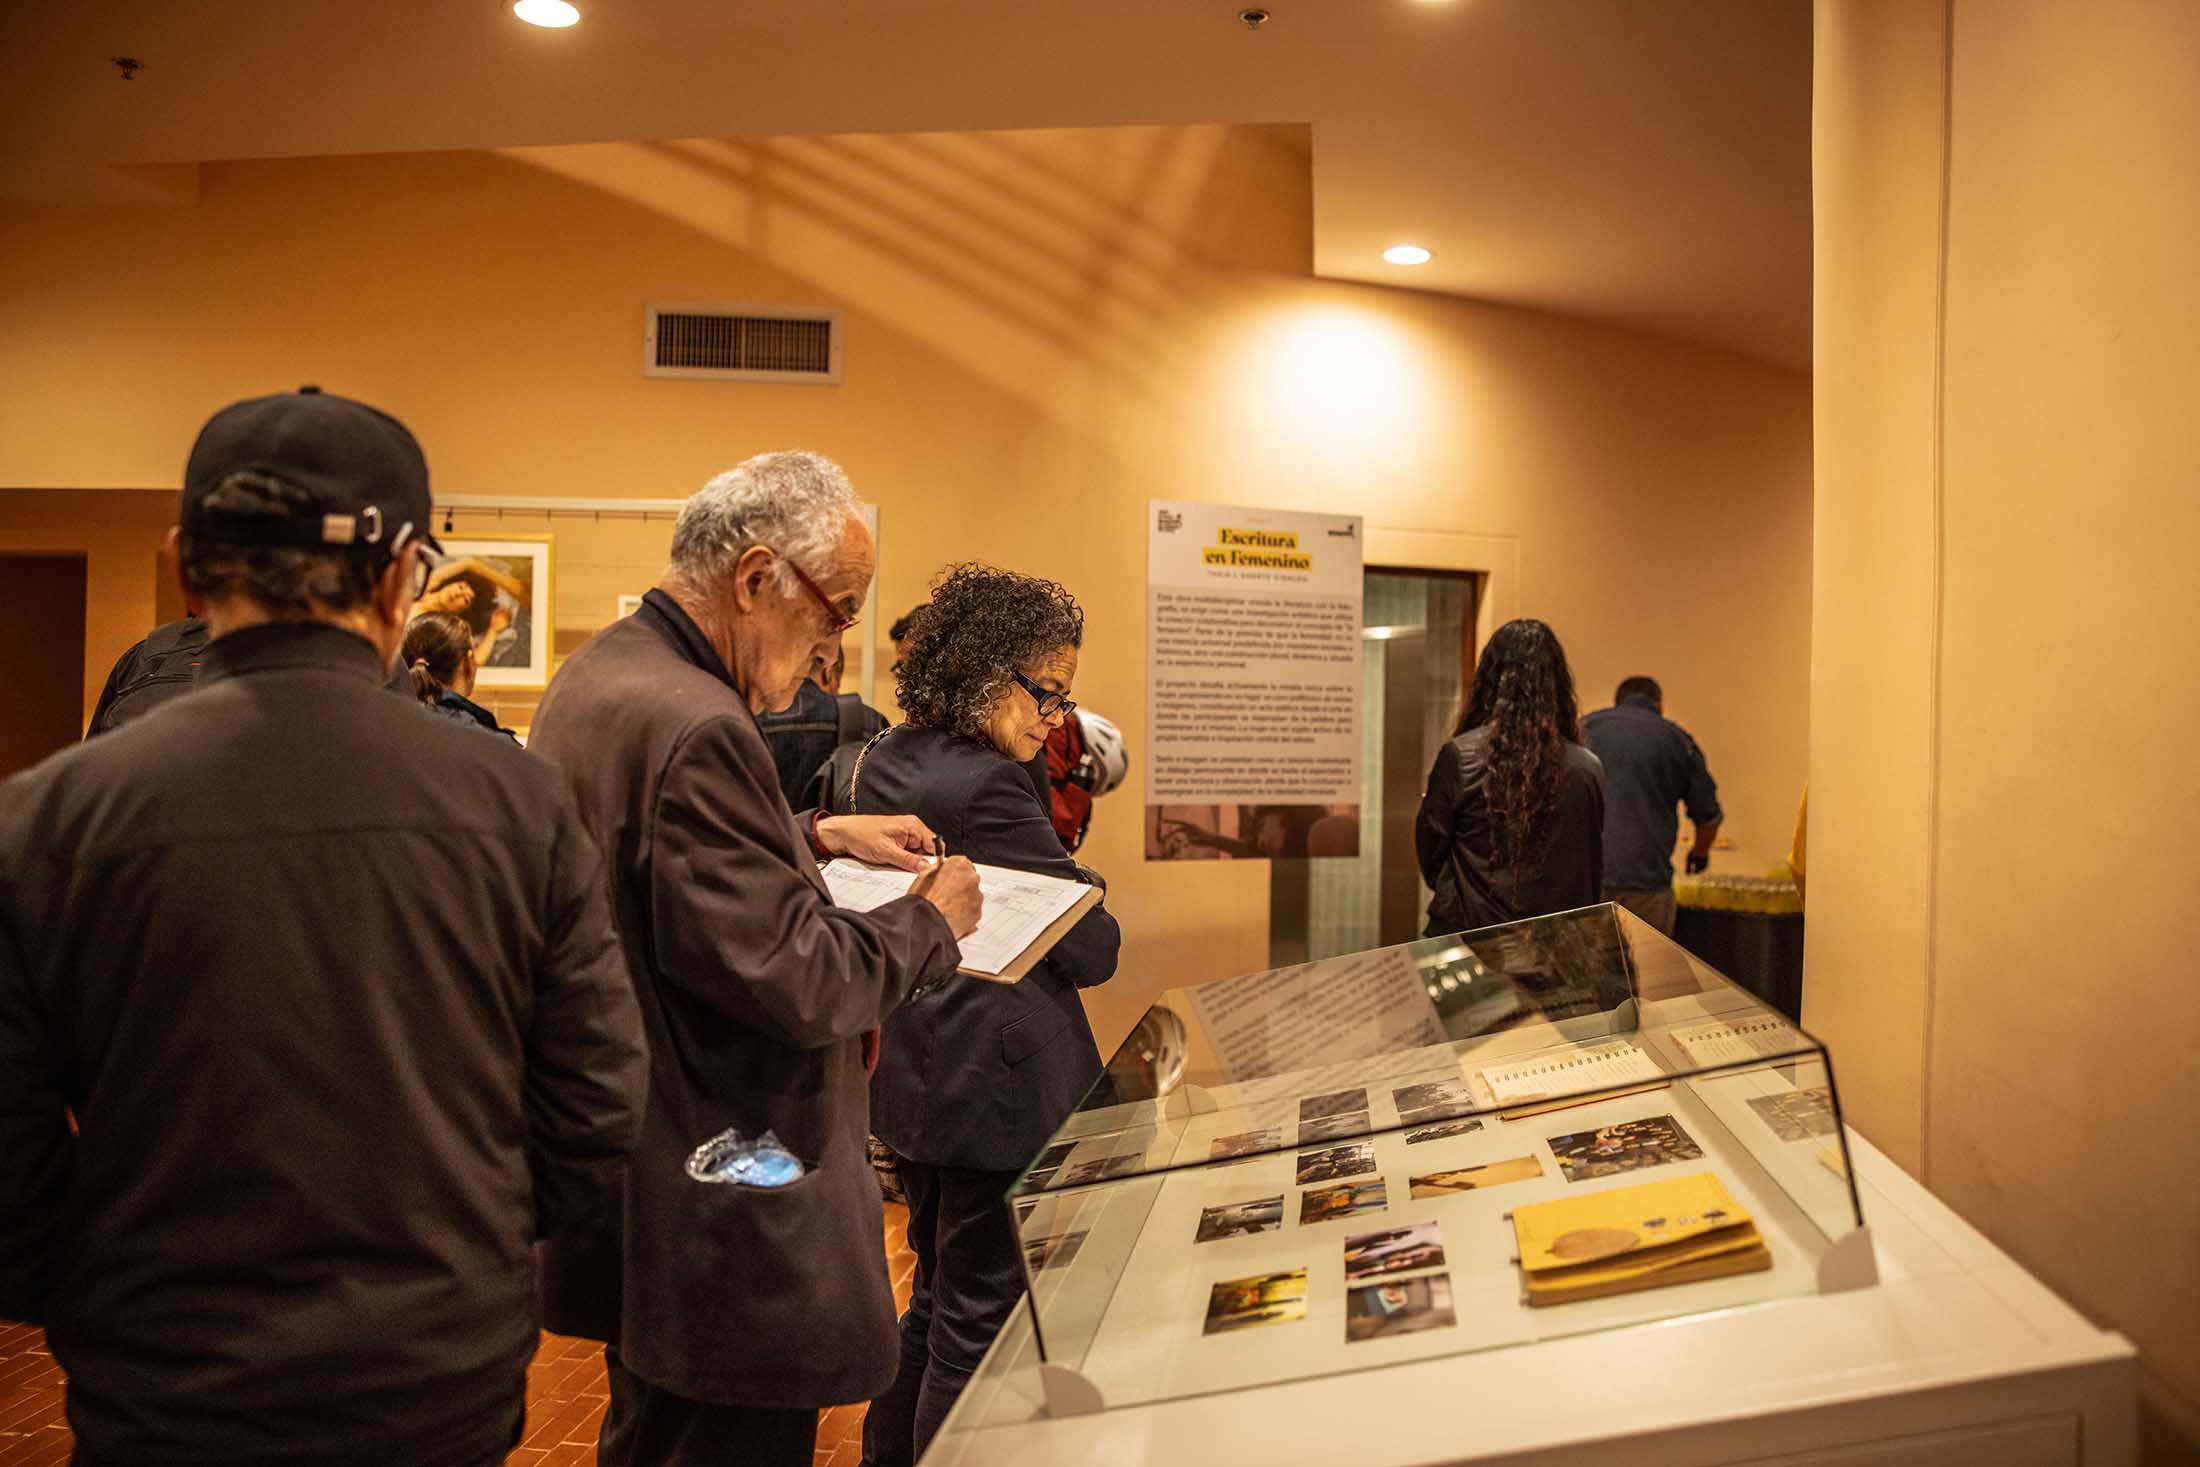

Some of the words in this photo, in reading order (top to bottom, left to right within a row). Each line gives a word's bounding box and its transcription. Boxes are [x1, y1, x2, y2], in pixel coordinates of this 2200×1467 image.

[1221, 529, 1296, 549] Escritura
[1205, 553, 1226, 565] en
[1231, 549, 1310, 570] Femenino
